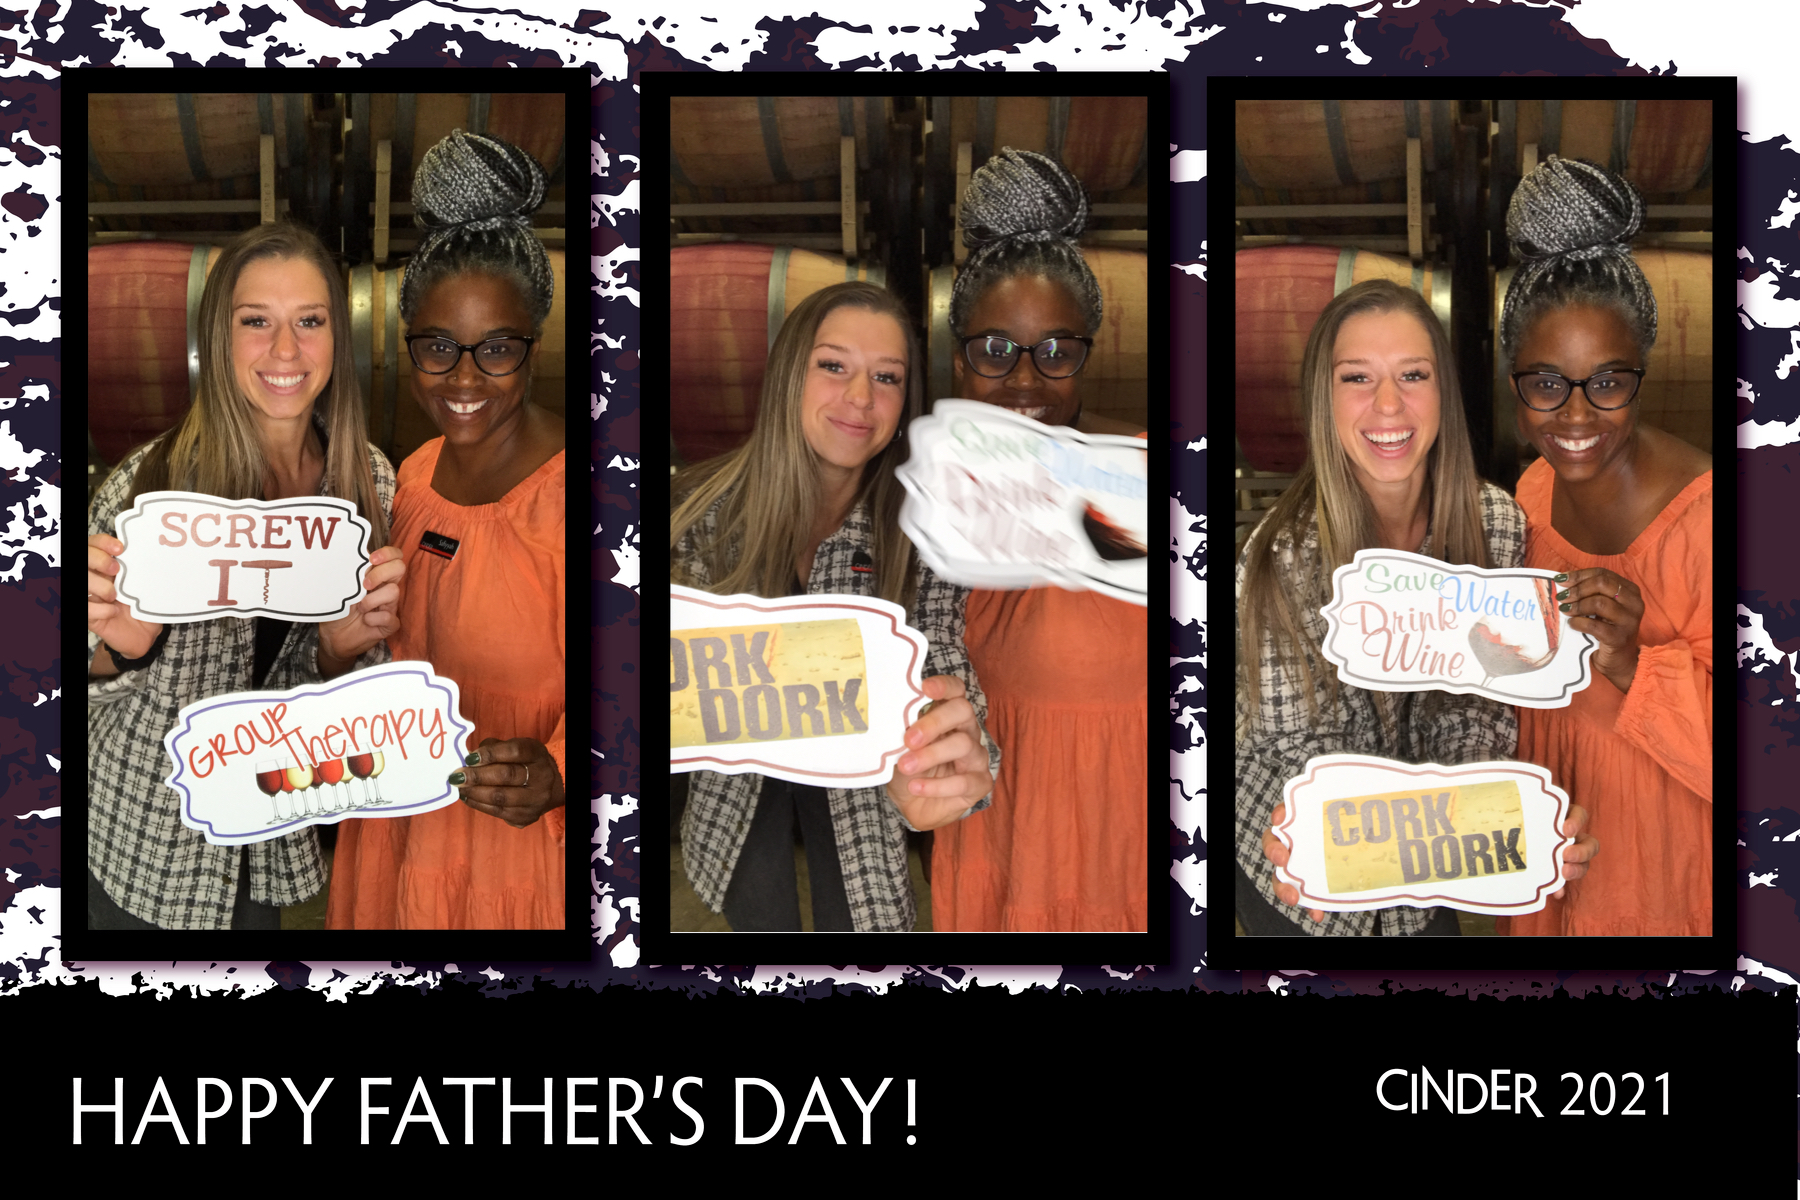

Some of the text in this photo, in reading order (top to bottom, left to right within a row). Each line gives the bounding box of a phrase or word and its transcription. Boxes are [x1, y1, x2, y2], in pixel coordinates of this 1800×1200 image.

[158, 512, 342, 550] SCREW
[207, 559, 293, 606] IT
[1364, 563, 1536, 621] Save Water
[1339, 597, 1459, 635] Drink
[1362, 627, 1465, 678] Wine
[698, 678, 869, 743] DORK
[189, 703, 447, 778] GROUP Therapy
[1326, 792, 1456, 846] CORK
[1398, 828, 1527, 883] DORK
